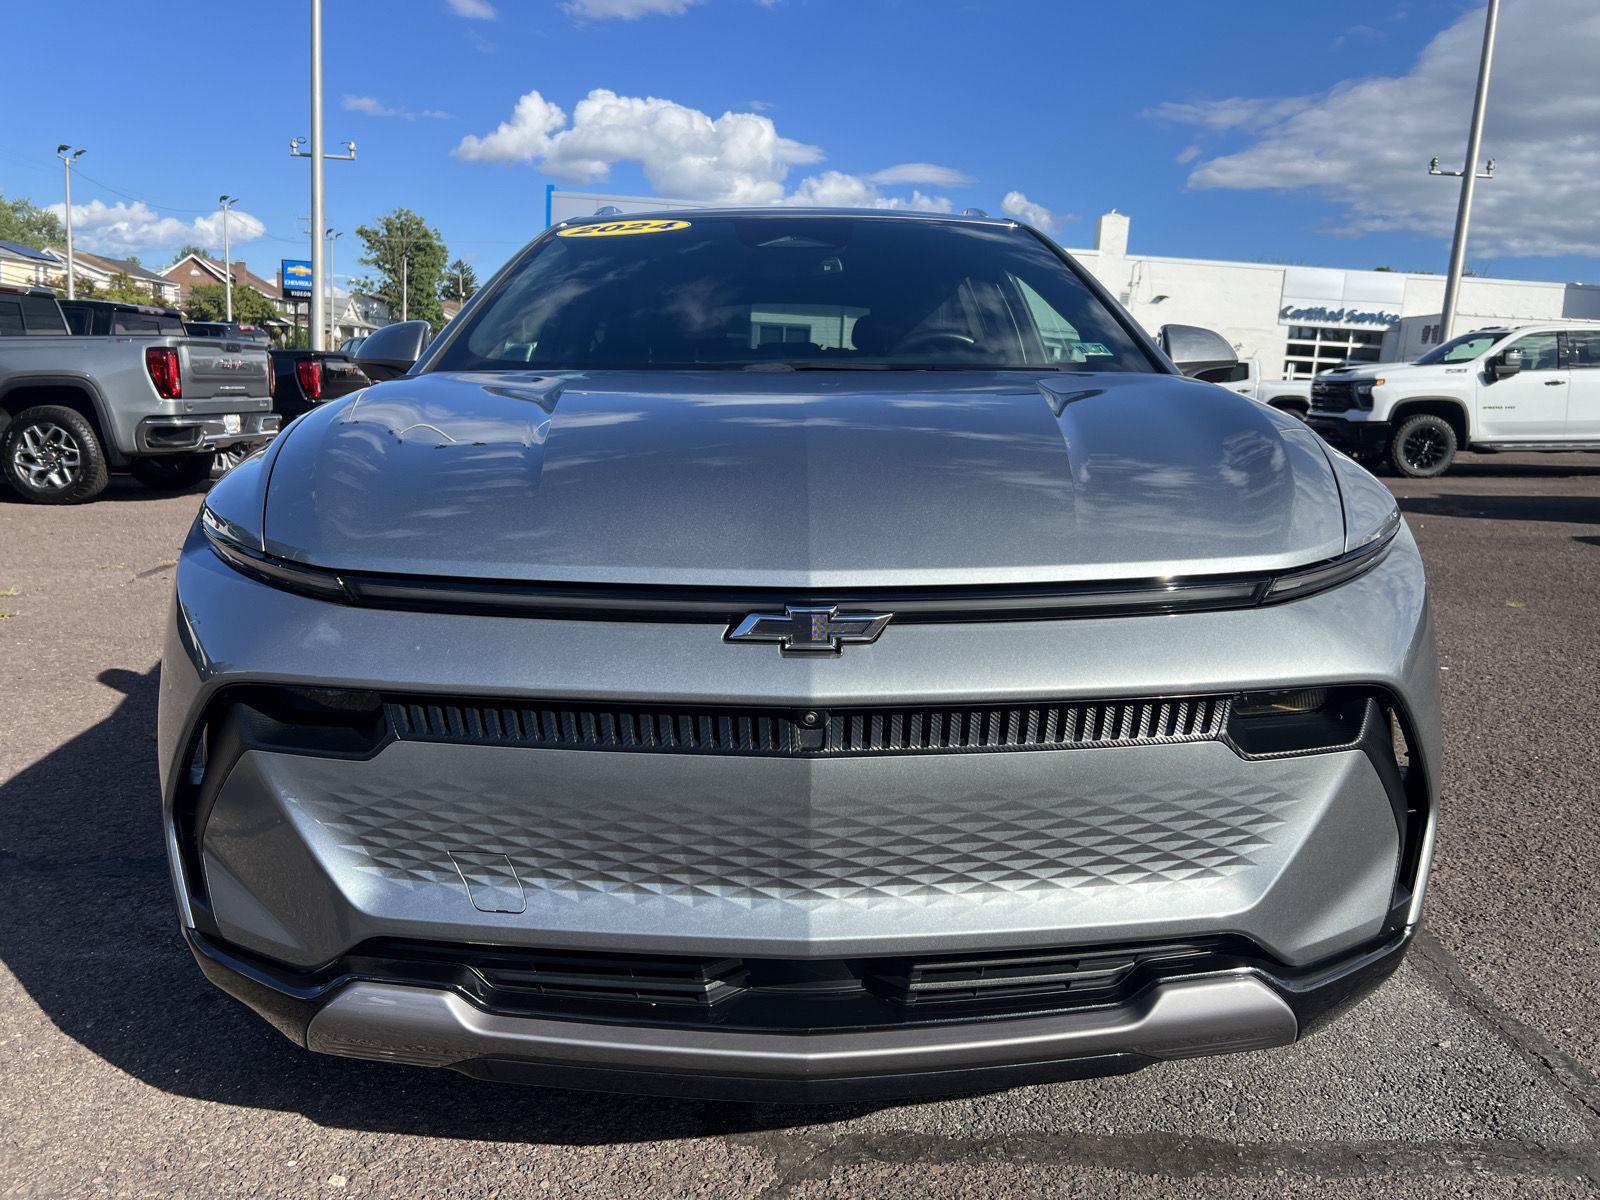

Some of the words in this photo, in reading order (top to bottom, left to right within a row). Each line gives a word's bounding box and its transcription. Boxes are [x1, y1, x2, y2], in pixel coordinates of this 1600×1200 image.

[570, 222, 677, 235] 2024
[291, 290, 312, 298] VIDEON
[1280, 305, 1345, 322] Certified
[1345, 309, 1401, 326] Service
